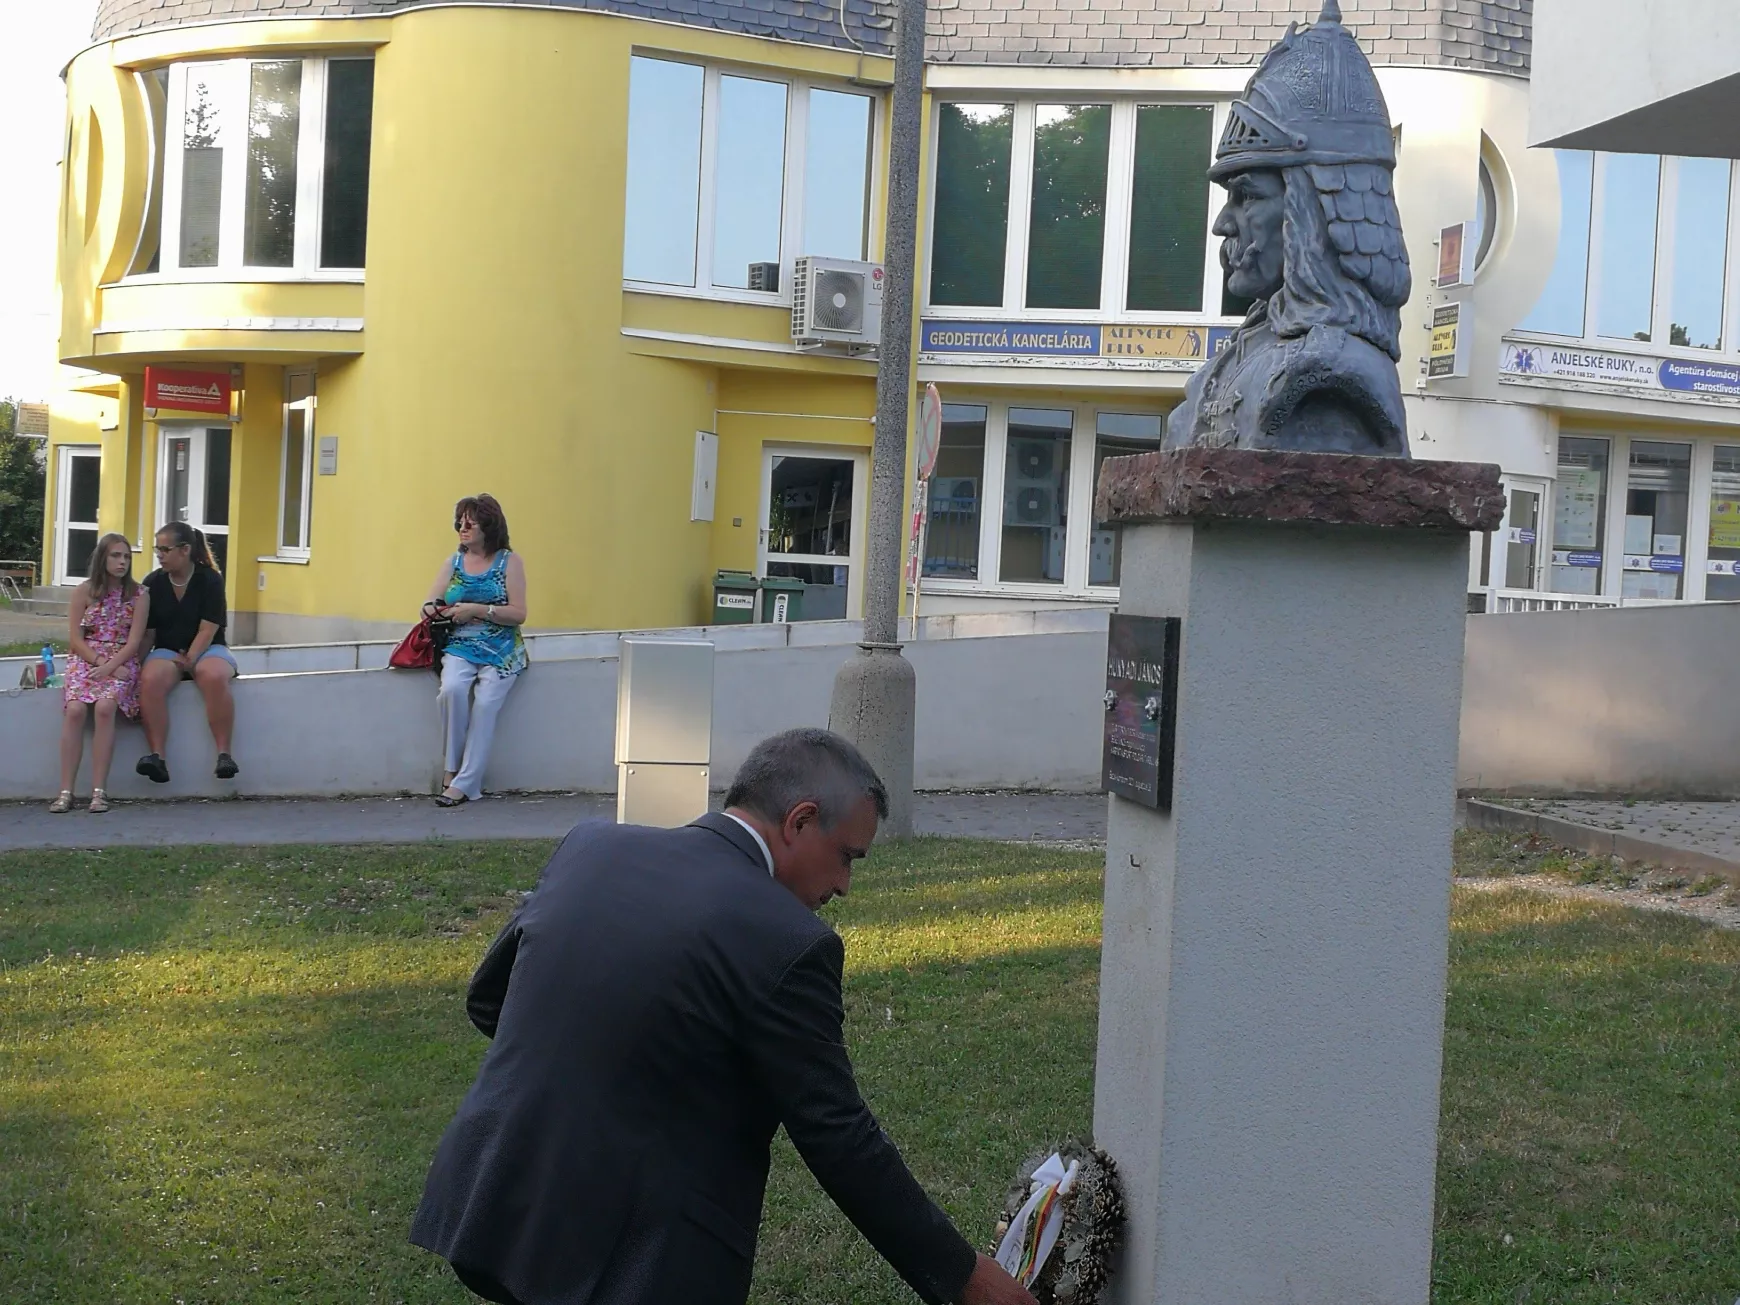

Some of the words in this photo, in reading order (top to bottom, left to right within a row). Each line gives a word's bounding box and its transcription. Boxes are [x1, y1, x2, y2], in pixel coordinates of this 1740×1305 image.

[929, 329, 1009, 348] GEODETICKÁ
[1012, 329, 1092, 349] KANCELÁRIA
[1551, 351, 1604, 369] ANJELSKÉ
[1606, 357, 1638, 373] RUKY,
[1639, 365, 1654, 374] n.o.
[1668, 363, 1705, 376] Agentúra
[1705, 367, 1739, 382] domácej
